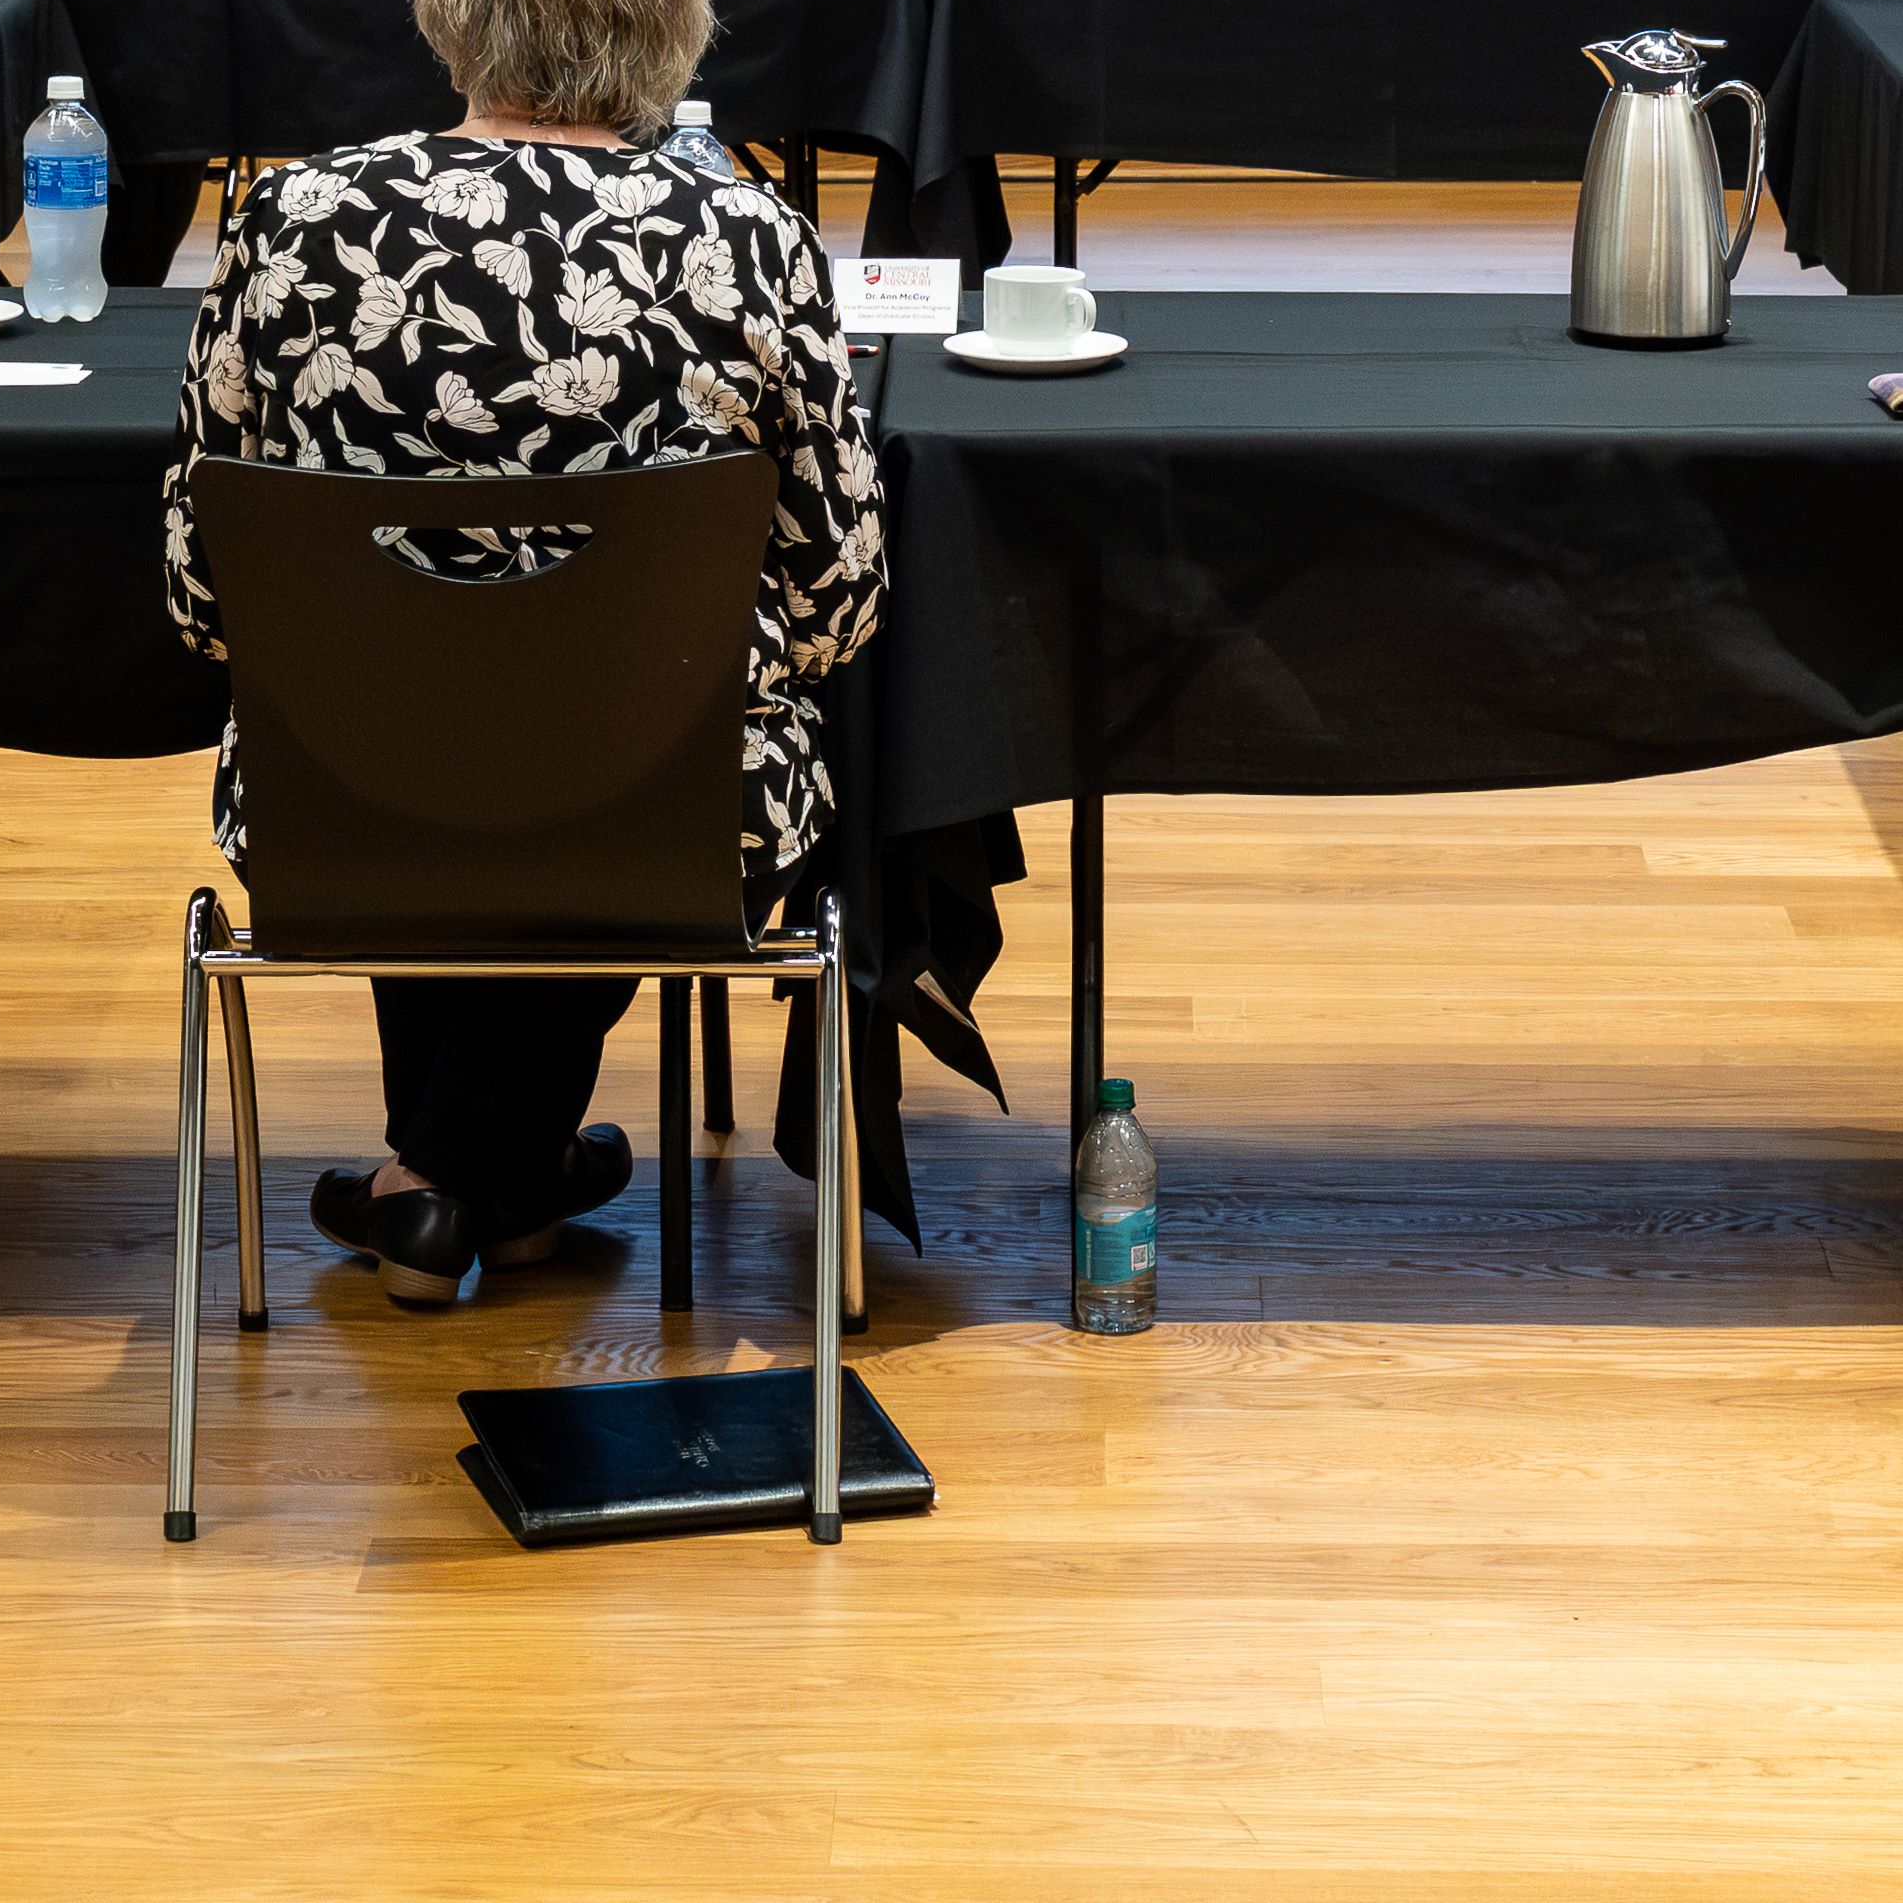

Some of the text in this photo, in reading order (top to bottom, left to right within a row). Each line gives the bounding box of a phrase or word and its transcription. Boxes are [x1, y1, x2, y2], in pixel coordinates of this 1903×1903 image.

[865, 292, 931, 302] Dr. Ann McCoy
